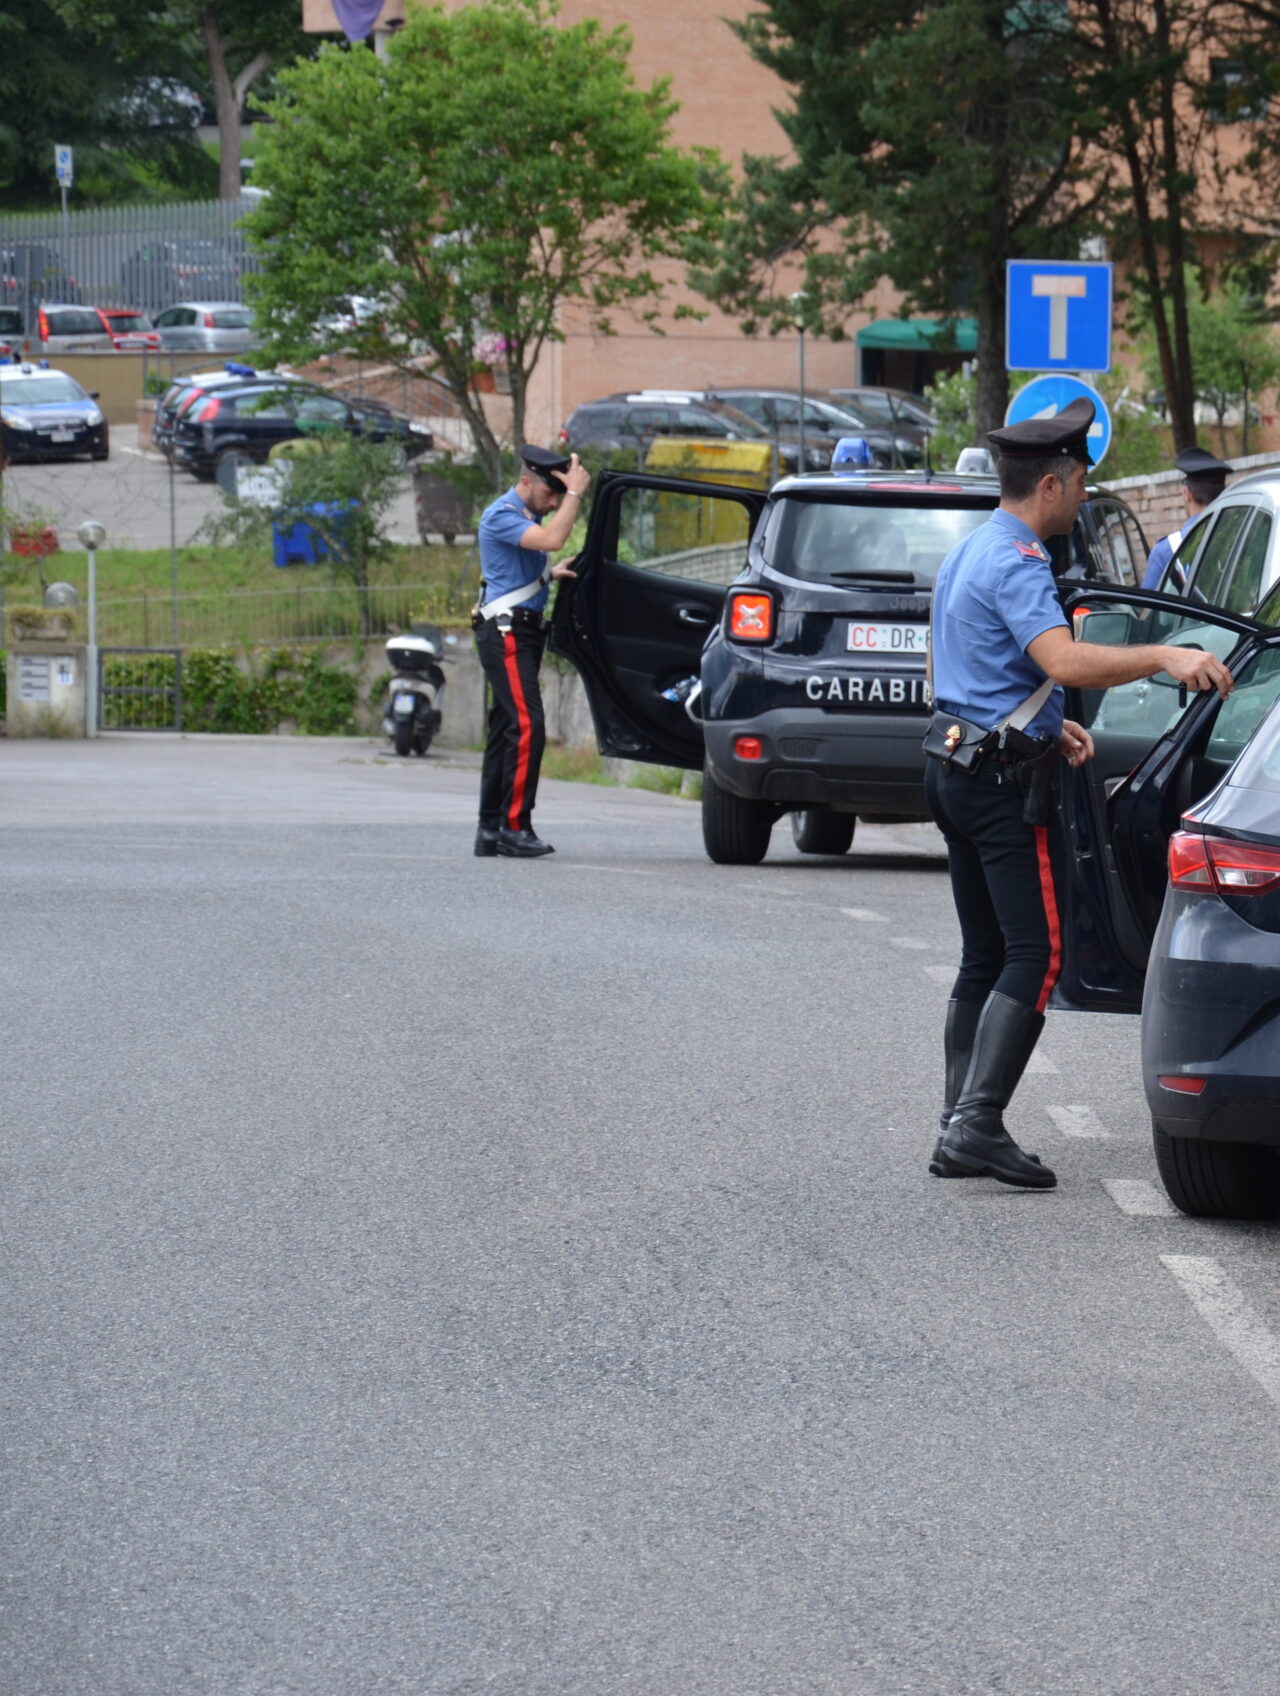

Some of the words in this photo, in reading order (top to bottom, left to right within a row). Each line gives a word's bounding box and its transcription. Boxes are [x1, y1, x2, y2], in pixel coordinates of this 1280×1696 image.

[889, 597, 926, 613] Jeep
[852, 626, 878, 648] CC
[890, 628, 916, 649] DR
